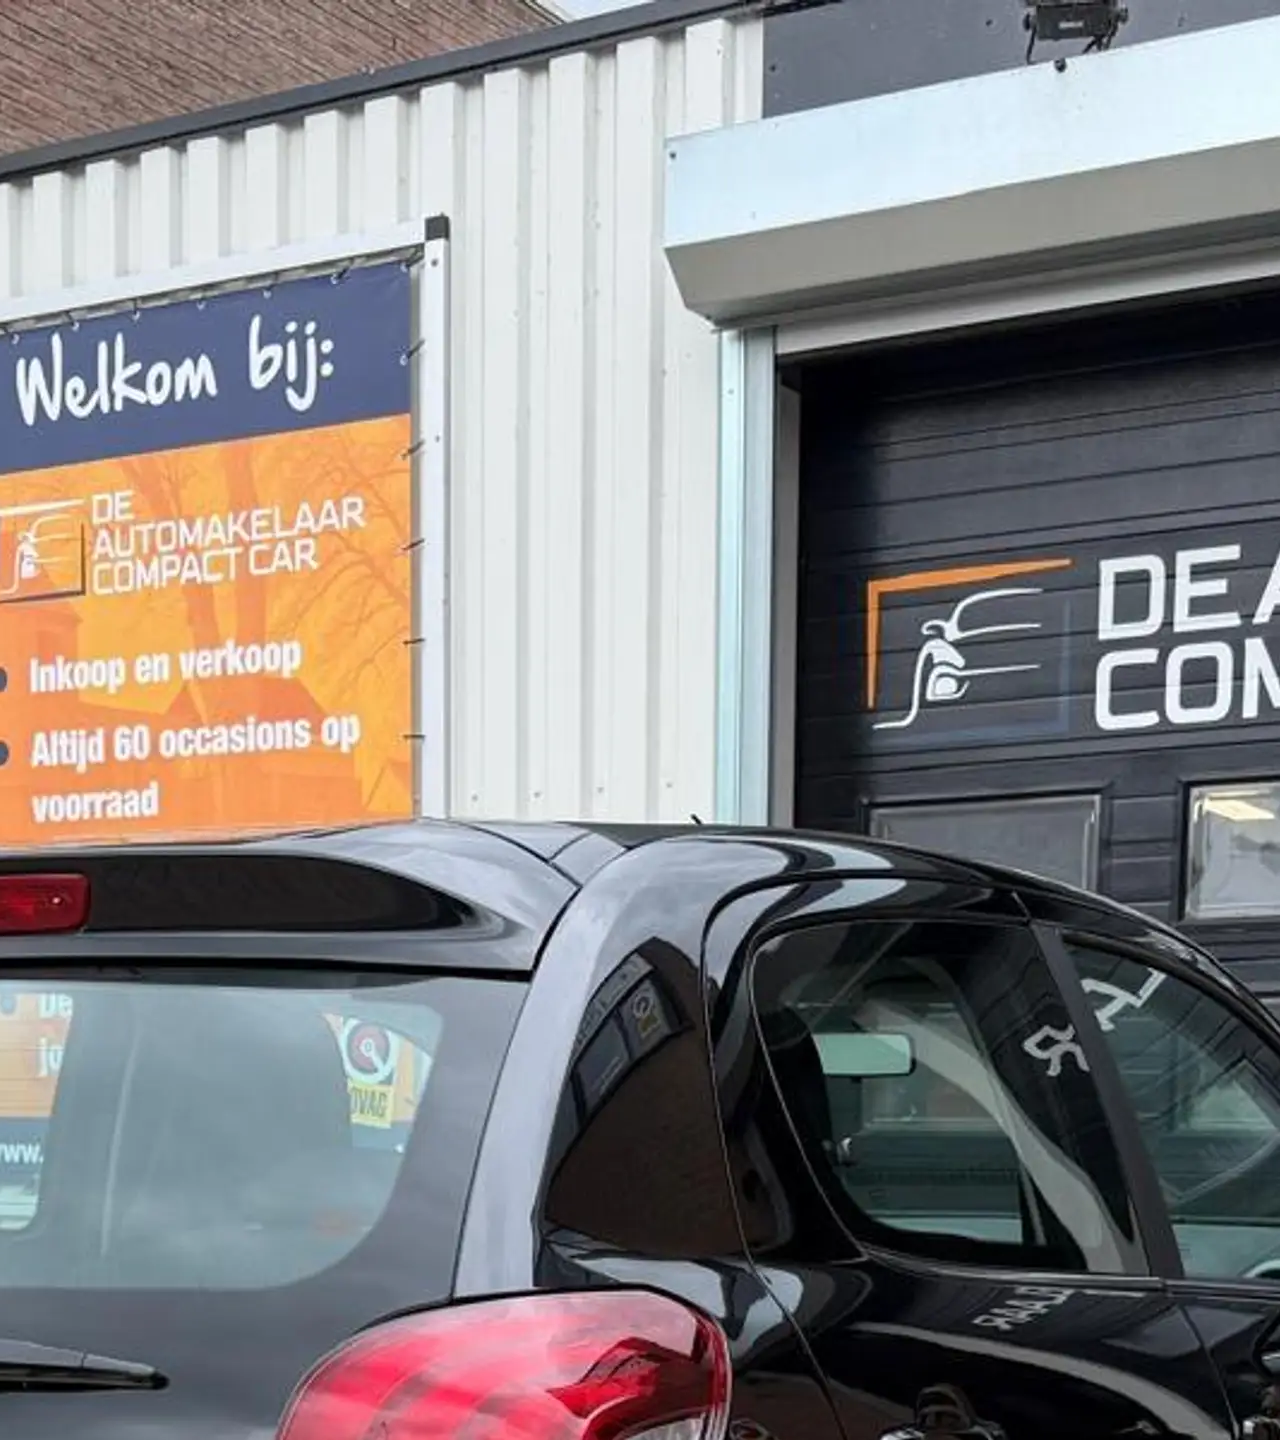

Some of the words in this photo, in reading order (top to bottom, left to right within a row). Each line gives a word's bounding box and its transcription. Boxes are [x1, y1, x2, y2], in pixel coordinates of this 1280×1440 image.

[16, 331, 218, 427] Welkom
[248, 313, 334, 412] bij:
[91, 490, 135, 525] DE
[91, 495, 367, 561] AUTOMAKELAAR
[91, 546, 244, 596] COMPACT
[248, 537, 319, 576] CAR
[1097, 543, 1242, 642] DE
[29, 655, 126, 694] Inkoop
[134, 652, 170, 683] en
[179, 638, 302, 681] verkoop
[30, 725, 105, 774] Altijd
[113, 724, 150, 761] 60
[158, 715, 312, 759] occasions
[321, 714, 361, 754] op
[31, 781, 160, 824] voorraad
